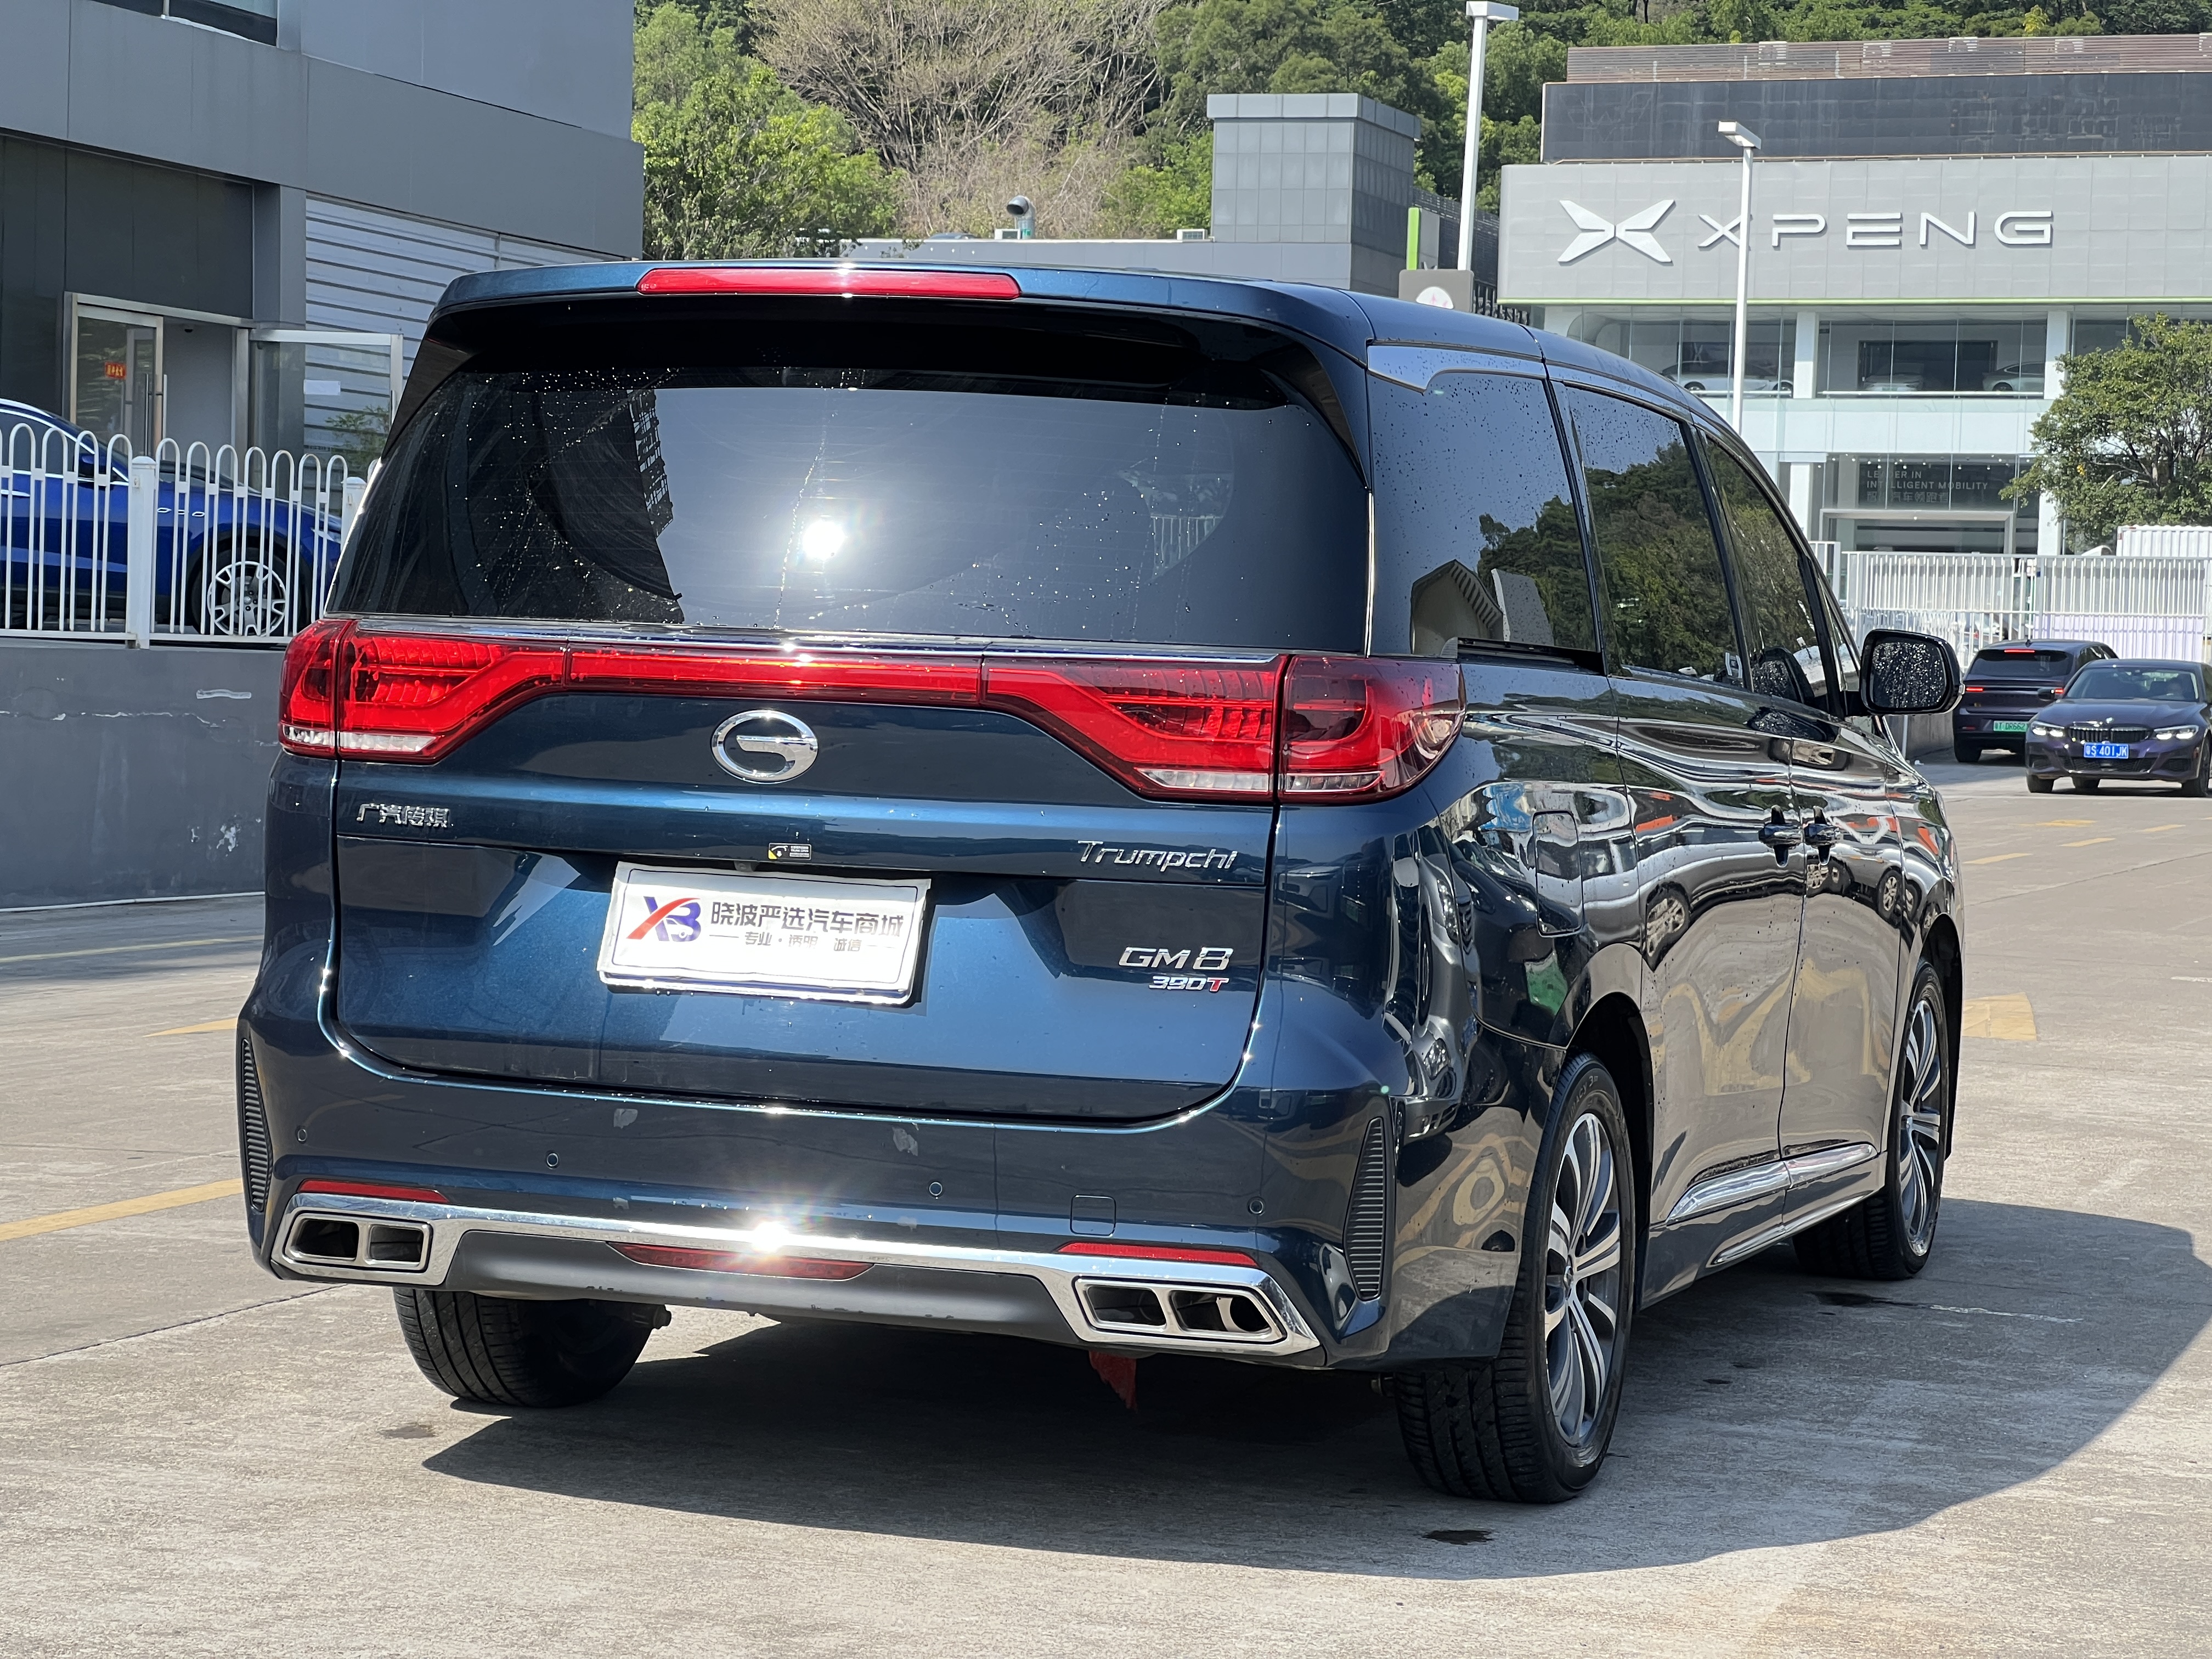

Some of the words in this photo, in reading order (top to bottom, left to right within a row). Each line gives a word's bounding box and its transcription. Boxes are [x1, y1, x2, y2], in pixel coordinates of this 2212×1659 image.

[1697, 211, 2053, 247] XPENG
[1867, 481, 1934, 489] INTLLIGENT
[1938, 481, 1988, 490] MOBILITY
[1867, 491, 1948, 503] 智汽车领跑者
[1077, 840, 1238, 871] Trumpchi
[710, 901, 904, 936] 晓波严选汽车商城
[1149, 976, 1229, 992] 390T
